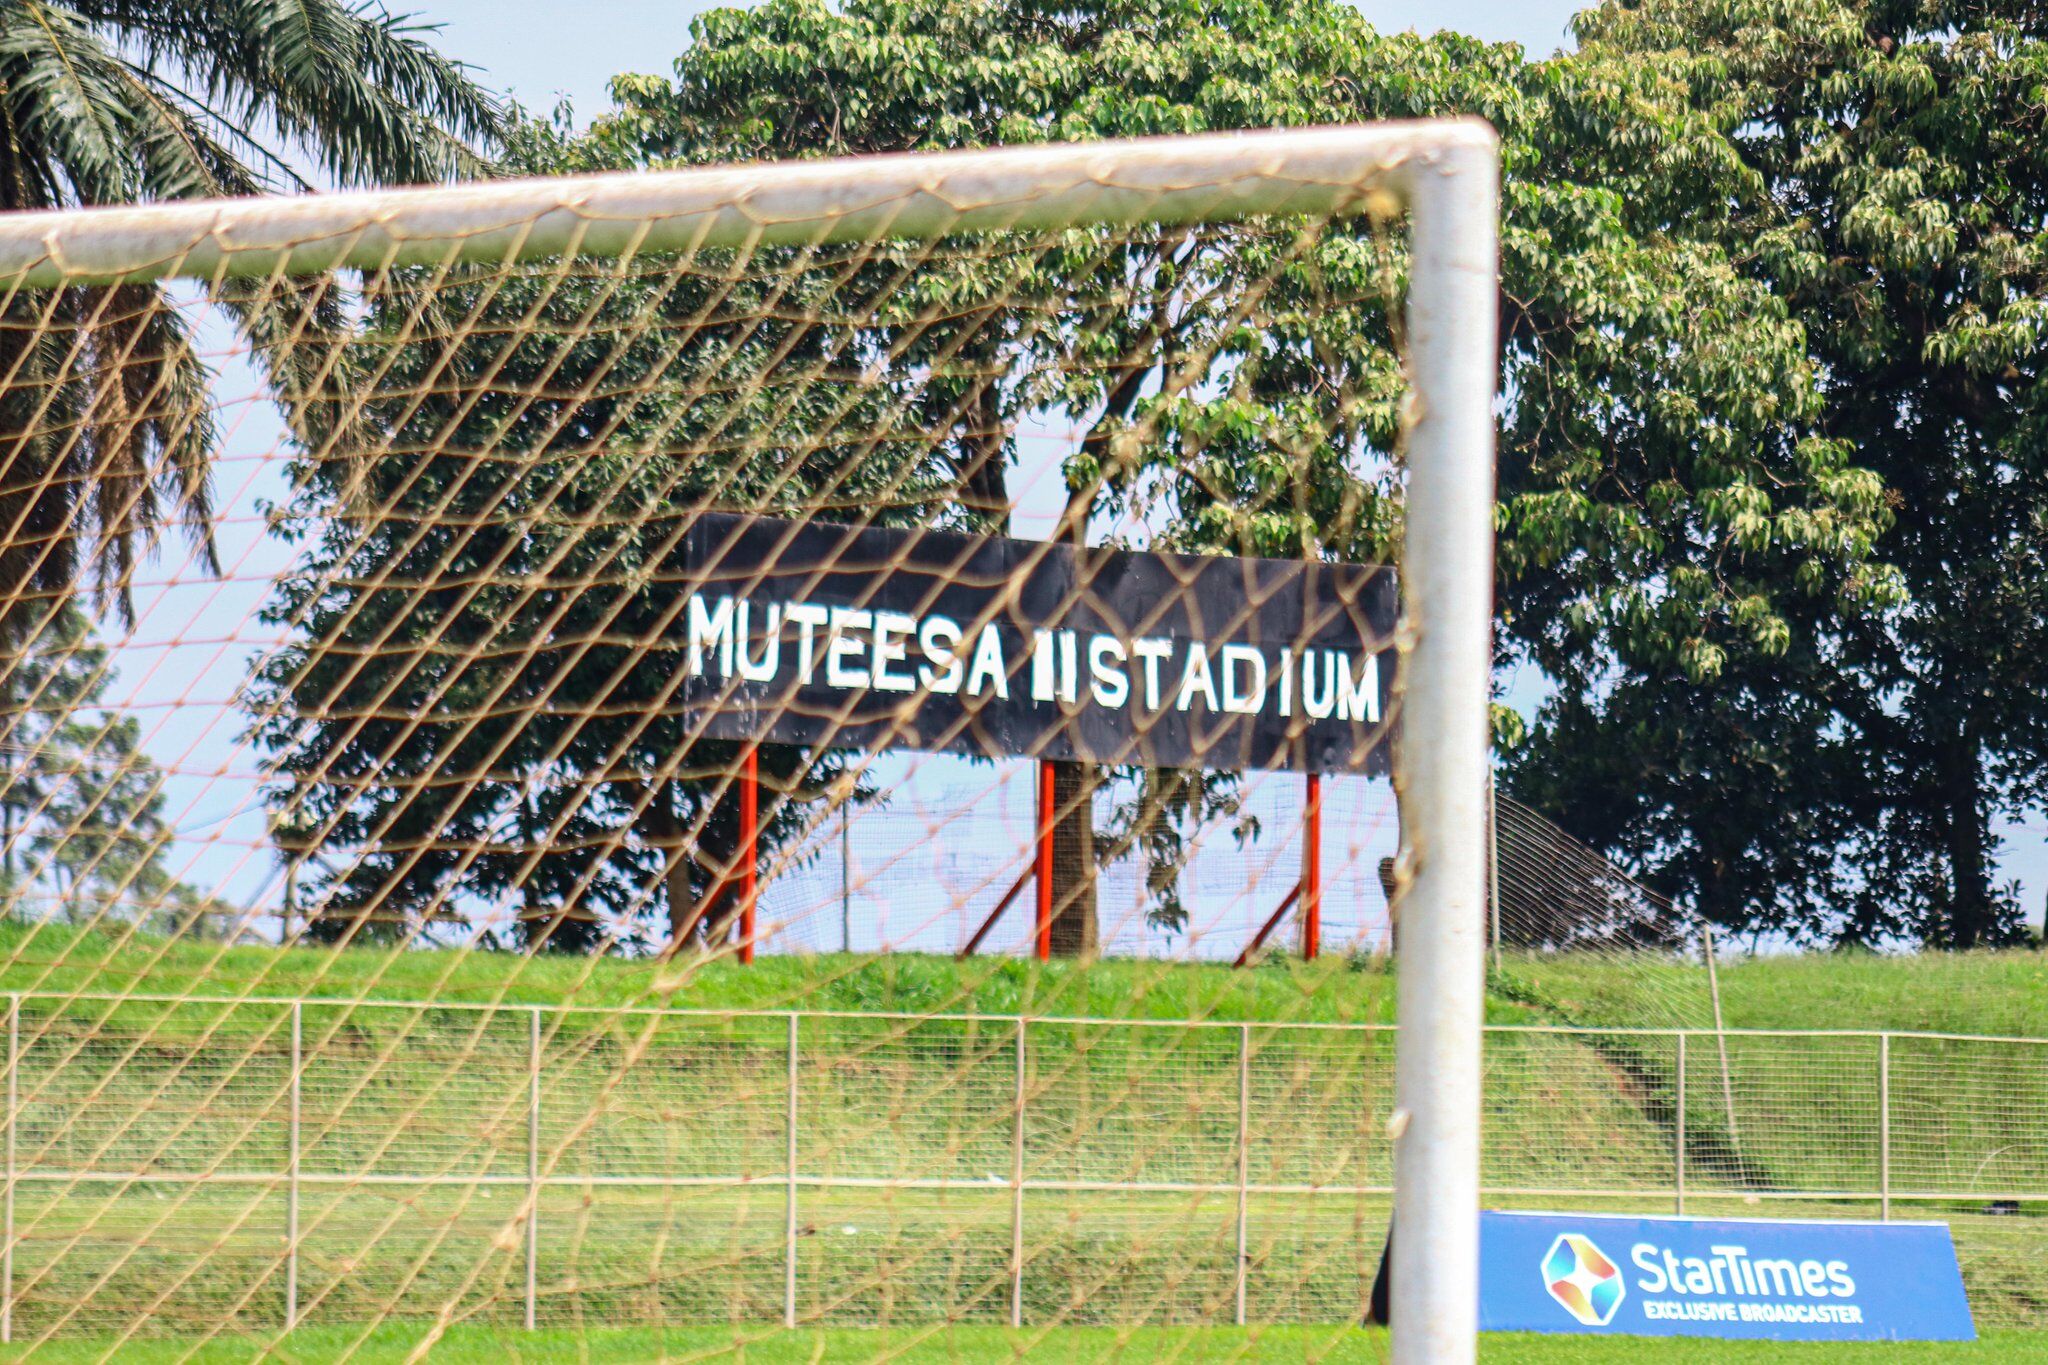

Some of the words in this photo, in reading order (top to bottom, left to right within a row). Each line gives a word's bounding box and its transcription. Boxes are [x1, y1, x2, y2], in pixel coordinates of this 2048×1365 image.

[688, 594, 1009, 700] MUTEESA
[1031, 628, 1077, 702] II
[1088, 637, 1381, 723] STADIUM
[1630, 1243, 1856, 1298] StarTimes
[1643, 1300, 1738, 1321] EXCLUSIVE
[1740, 1303, 1864, 1325] BROADCASTER
